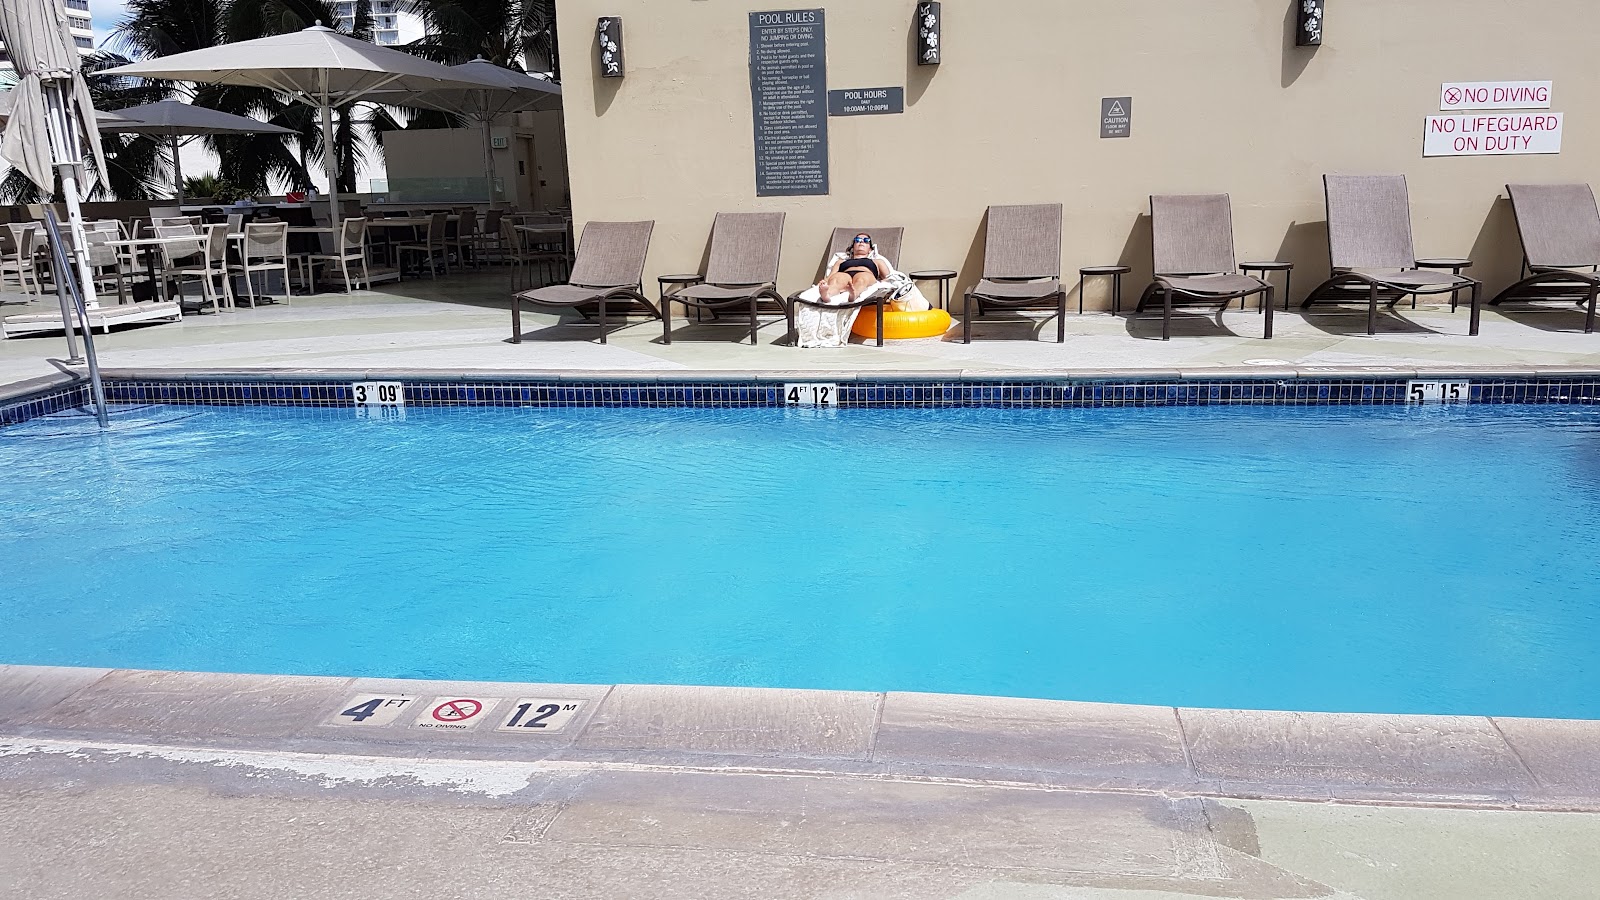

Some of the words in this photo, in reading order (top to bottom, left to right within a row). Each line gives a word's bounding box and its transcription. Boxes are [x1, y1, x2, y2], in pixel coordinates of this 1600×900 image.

[760, 14, 783, 24] POOL
[786, 12, 814, 23] RULES
[864, 90, 886, 98] HOURS
[1465, 88, 1488, 102] NO
[1494, 87, 1547, 102] DIVING
[1432, 118, 1455, 132] NO
[1462, 117, 1557, 132] LIFEGUARD
[1454, 137, 1478, 151] ON
[1486, 136, 1532, 150] DUTY
[356, 386, 366, 402] 3
[788, 387, 799, 402] 4
[1410, 384, 1424, 400] 5
[341, 699, 384, 722] 4
[507, 703, 560, 728] 1.2
